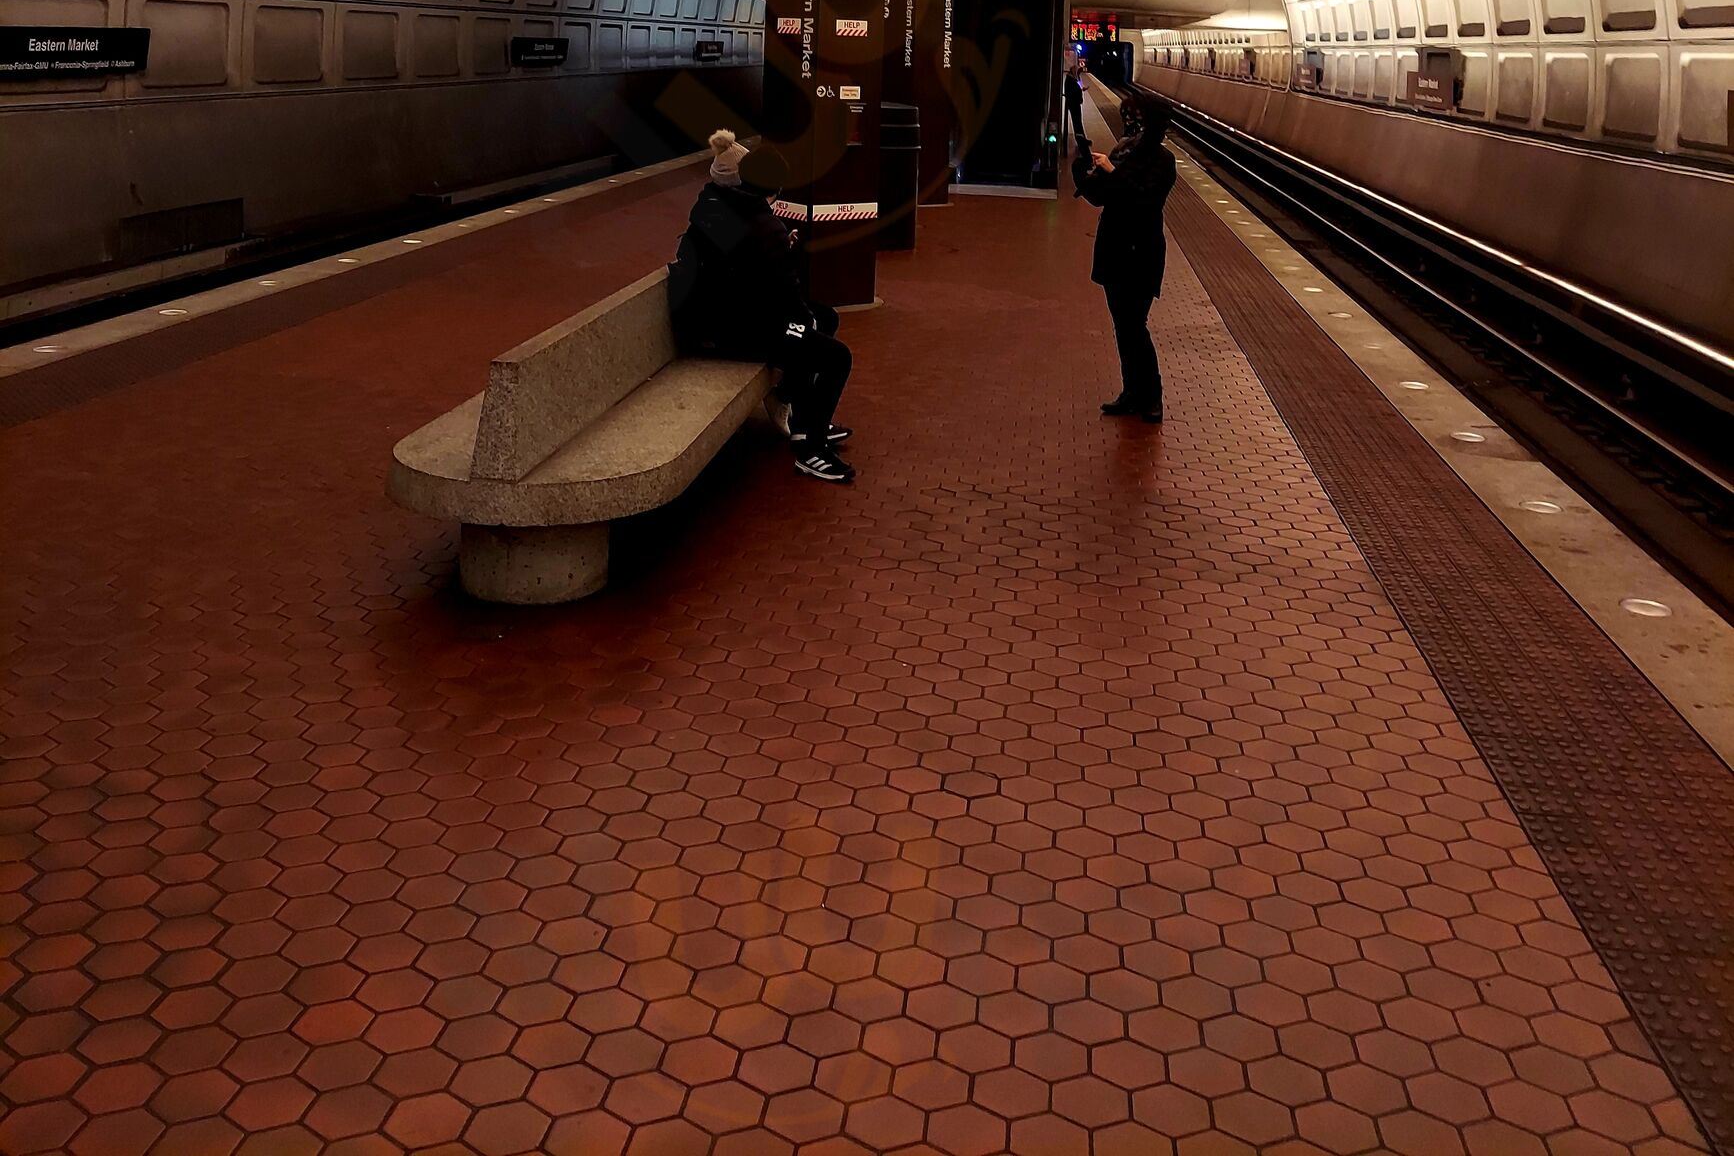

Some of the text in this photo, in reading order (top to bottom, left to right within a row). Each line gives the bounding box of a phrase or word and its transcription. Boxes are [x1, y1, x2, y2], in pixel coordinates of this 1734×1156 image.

[843, 21, 861, 29] HELP
[28, 38, 99, 52] Eastern Market
[801, 17, 814, 79] Market
[904, 29, 913, 67] Market
[943, 31, 953, 68] Market
[776, 202, 789, 210] HELP
